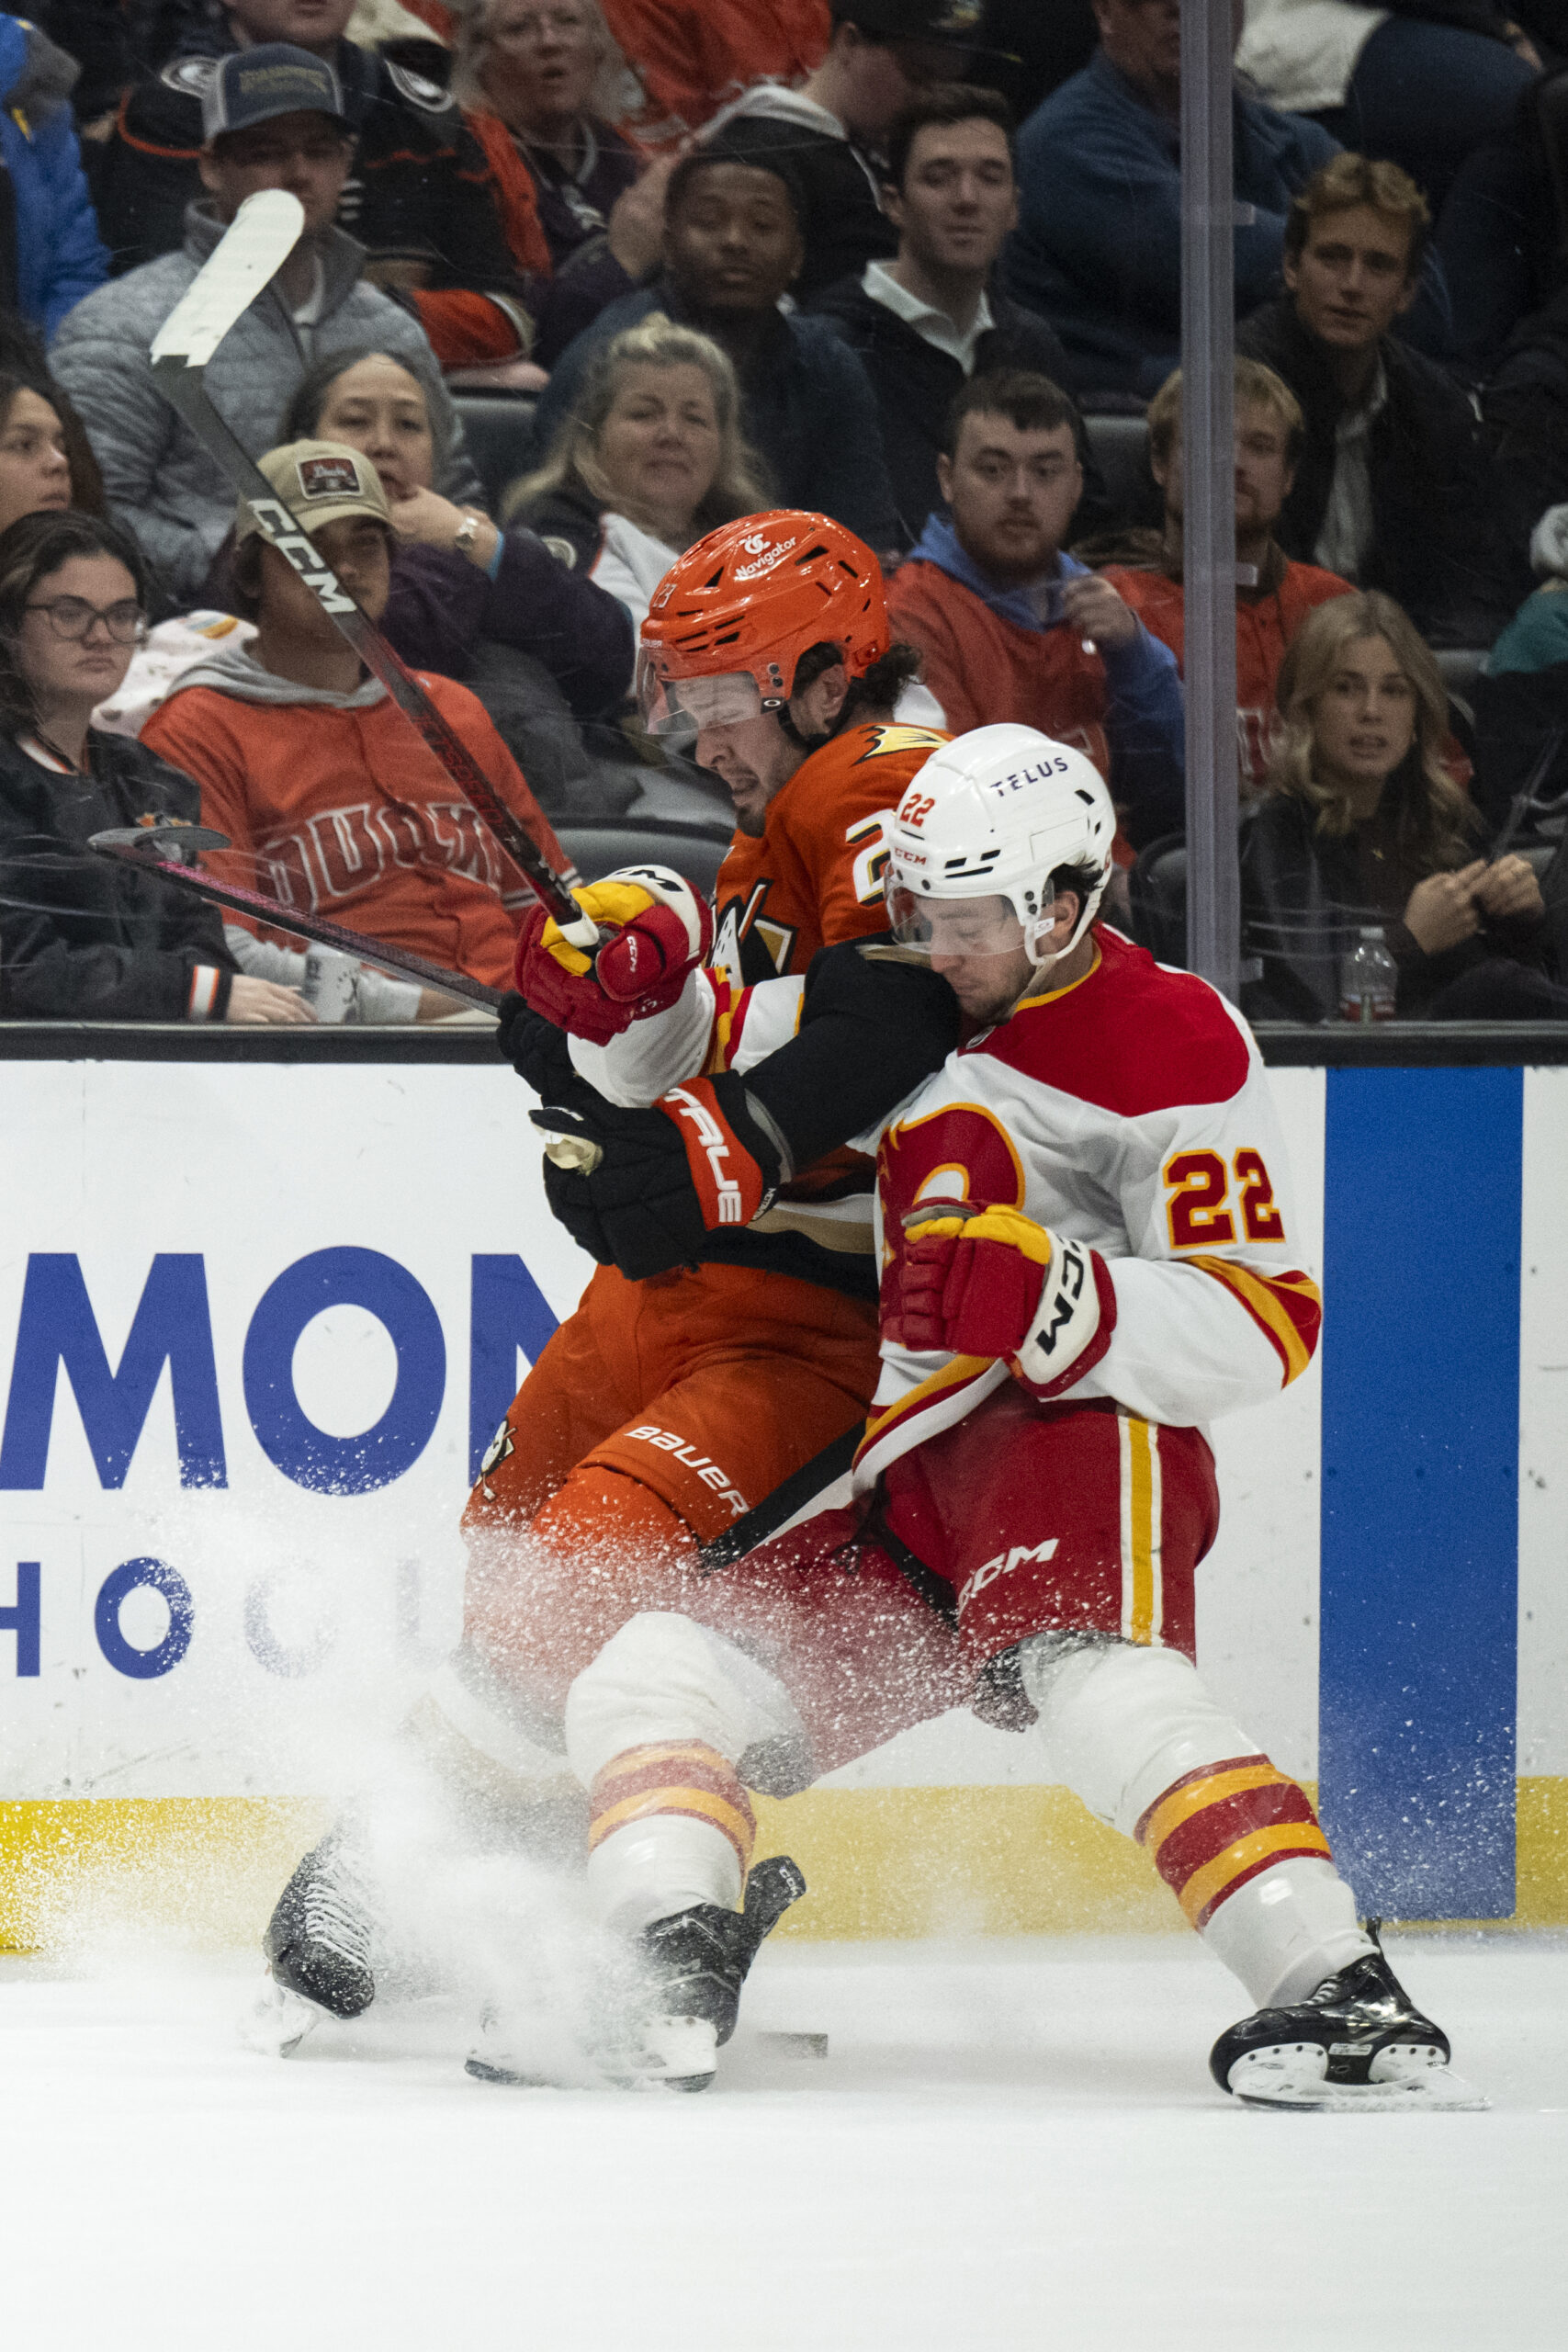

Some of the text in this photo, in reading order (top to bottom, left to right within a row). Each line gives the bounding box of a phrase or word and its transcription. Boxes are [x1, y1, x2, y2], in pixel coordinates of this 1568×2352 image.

[247, 499, 357, 614] CCM
[735, 536, 797, 579] Navigator
[652, 583, 678, 609] 23
[990, 757, 1068, 797] TELUS
[899, 793, 935, 828] 22
[894, 847, 927, 866] CCM
[663, 1088, 742, 1223] TRUE
[1162, 1147, 1286, 1250] 22
